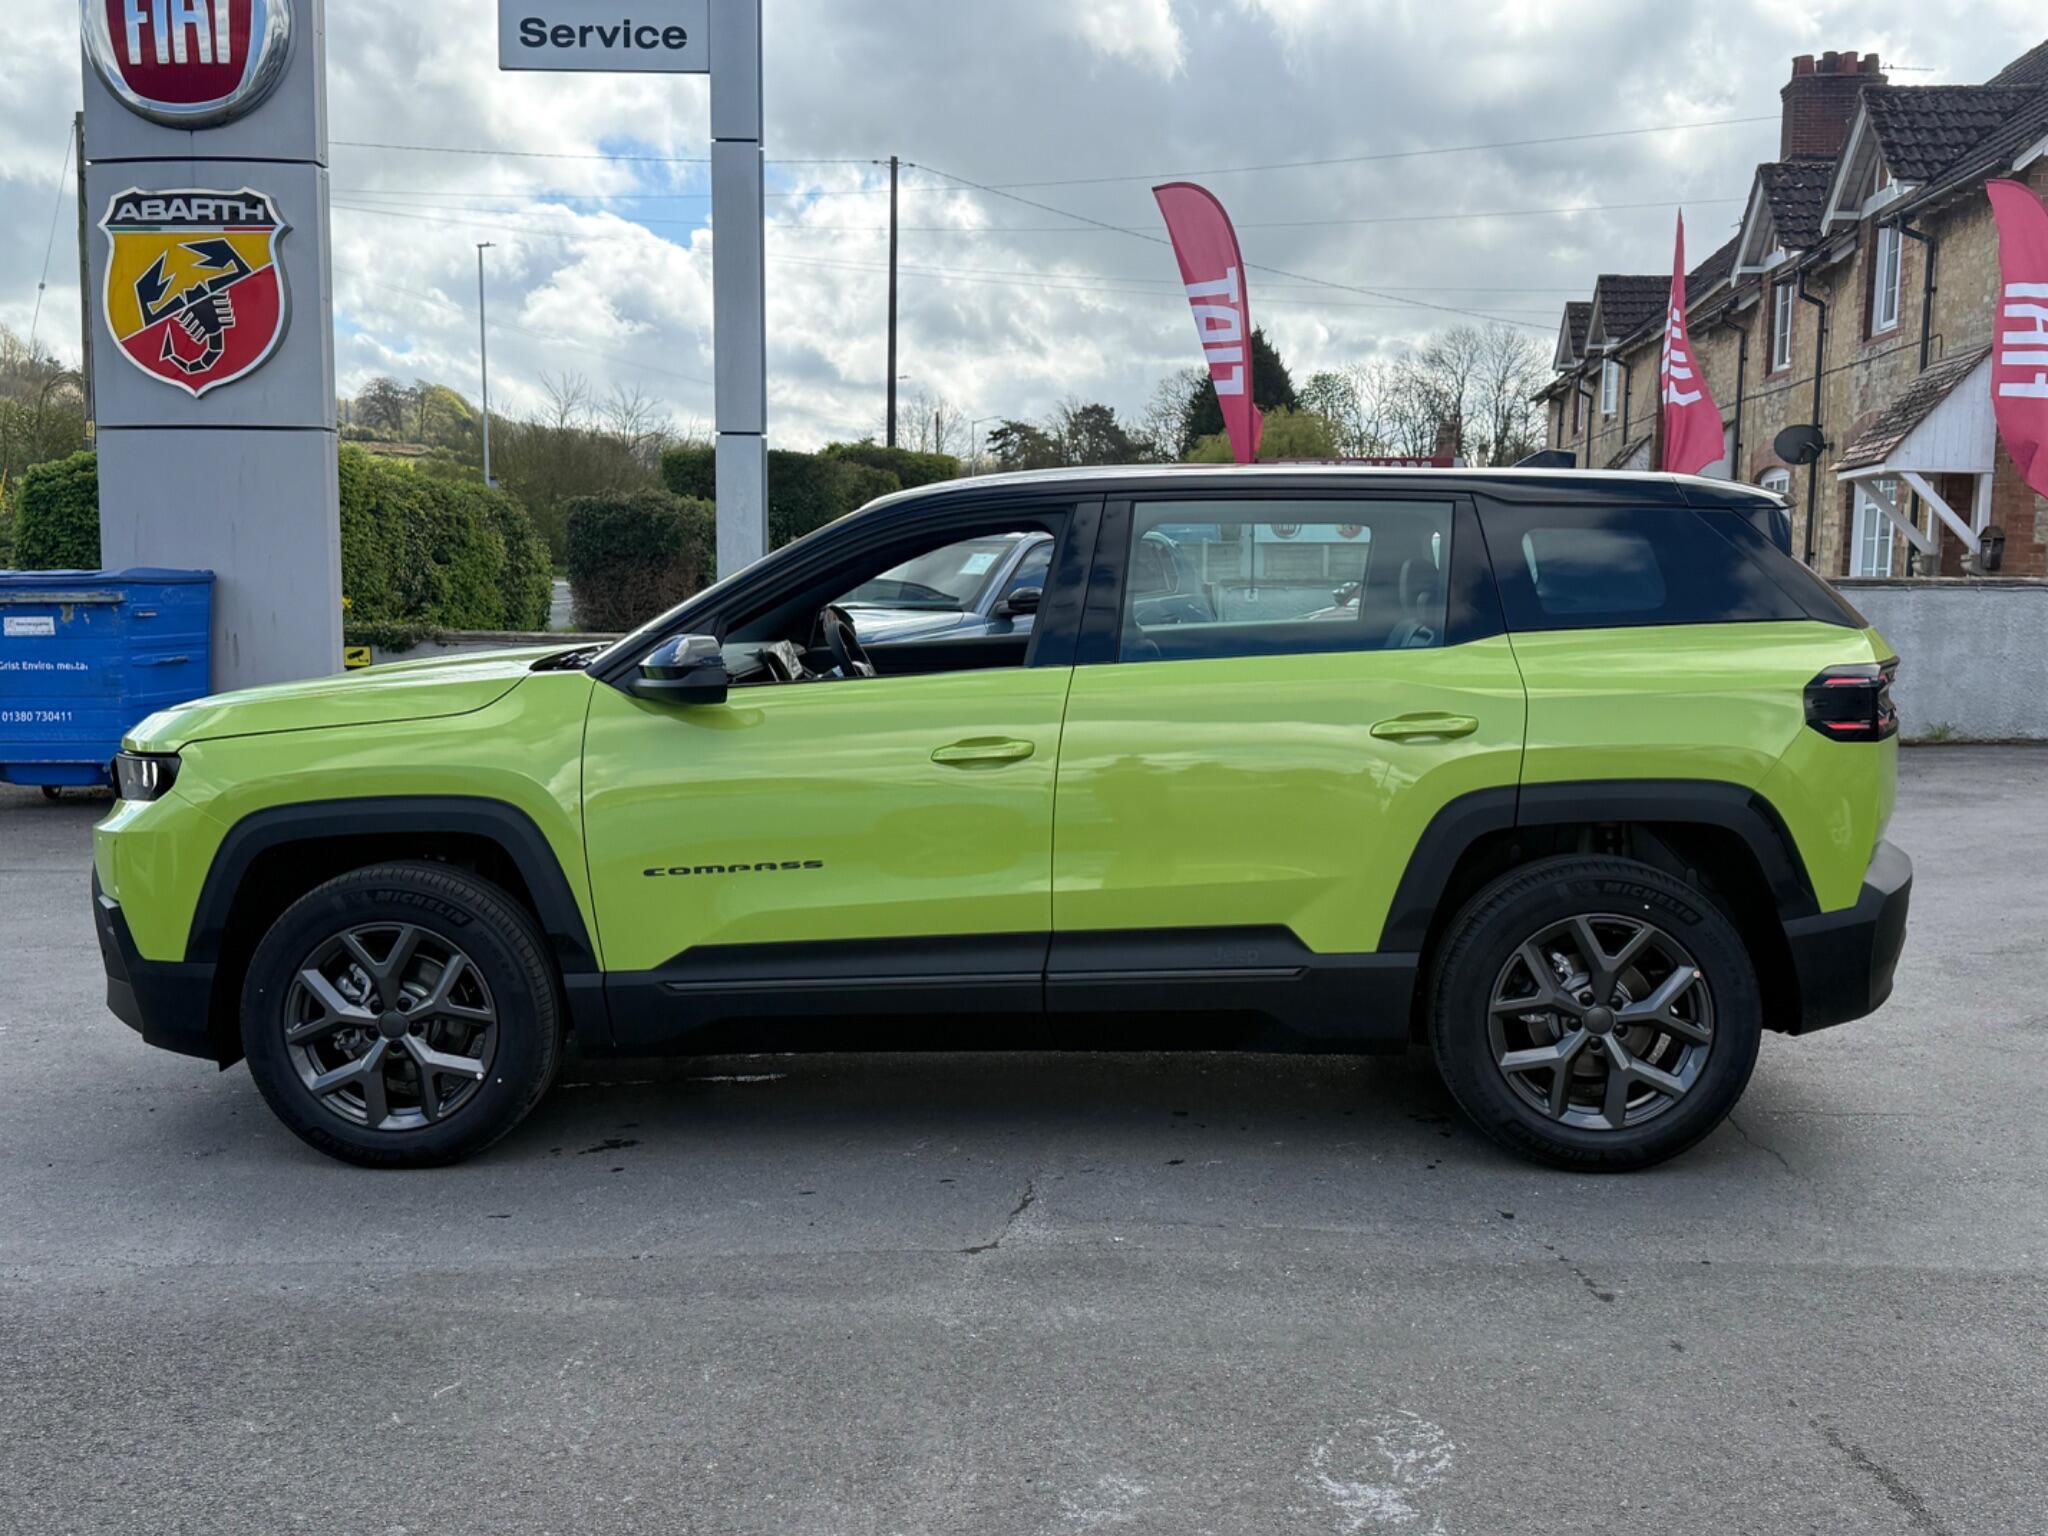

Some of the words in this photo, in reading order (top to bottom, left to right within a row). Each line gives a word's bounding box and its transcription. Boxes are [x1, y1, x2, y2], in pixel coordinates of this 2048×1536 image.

[124, 0, 231, 65] FIAT
[519, 17, 688, 50] Service
[114, 198, 265, 221] ABARTH
[1, 711, 34, 722] 01380
[35, 711, 73, 722] 730411
[643, 860, 824, 877] COMPASS
[374, 889, 467, 925] MICHELIN
[1603, 880, 1699, 923] MICHELIN
